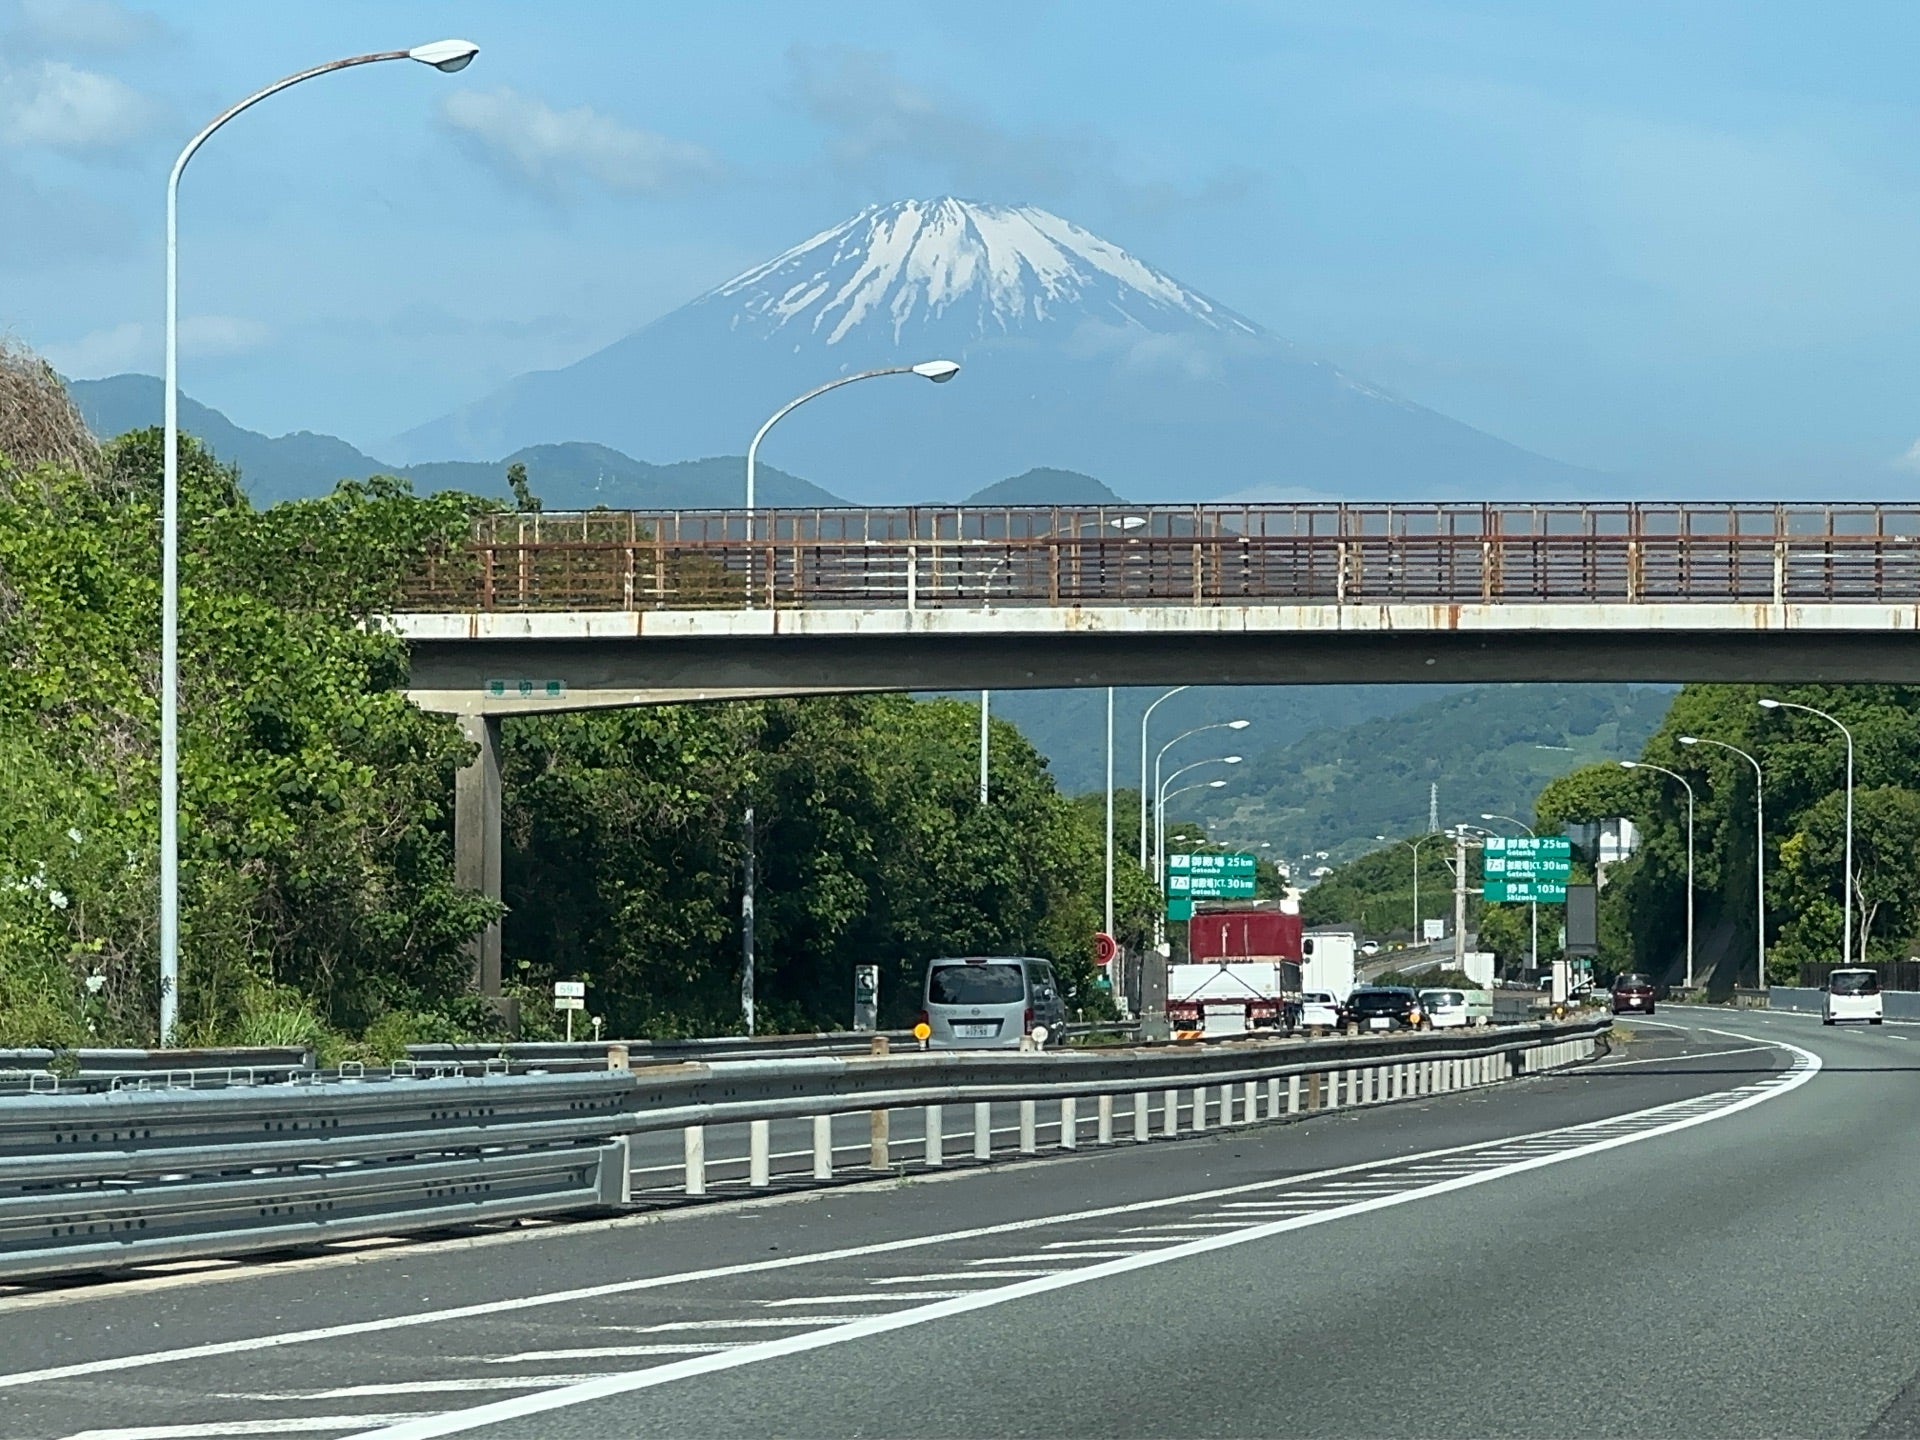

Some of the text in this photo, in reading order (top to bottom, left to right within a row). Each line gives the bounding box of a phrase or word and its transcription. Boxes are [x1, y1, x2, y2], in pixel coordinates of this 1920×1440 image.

[1506, 849, 1536, 857] Gotenba
[1489, 861, 1503, 869] 7-1
[1191, 866, 1220, 874] Gotenba
[1506, 870, 1536, 878] Gotenba
[1173, 878, 1187, 887] 7-1
[1191, 888, 1220, 896] Gotenba
